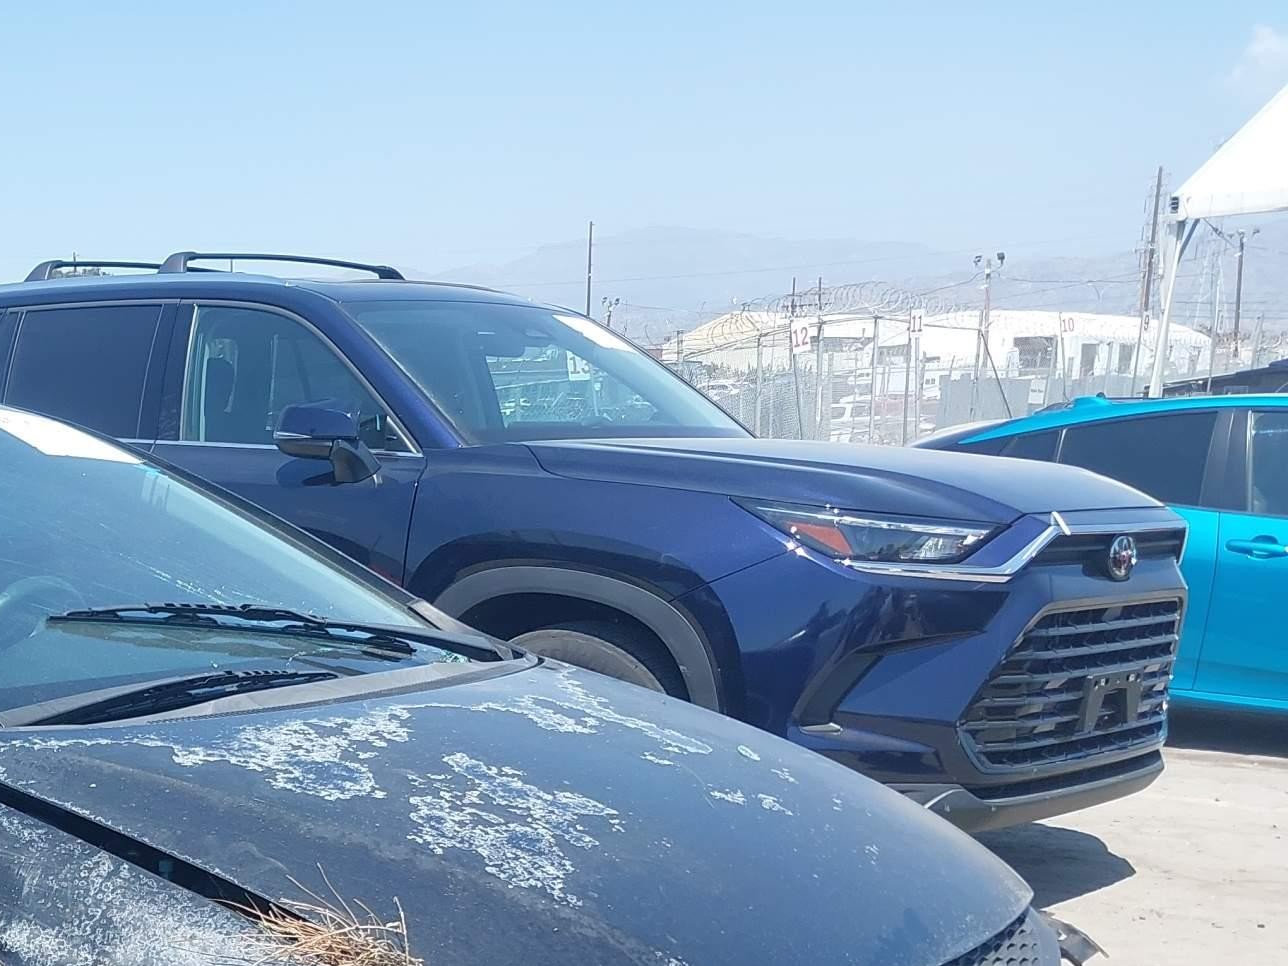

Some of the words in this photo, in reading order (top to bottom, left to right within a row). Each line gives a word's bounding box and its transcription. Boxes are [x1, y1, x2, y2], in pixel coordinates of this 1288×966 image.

[911, 315, 922, 332] 11
[1062, 317, 1075, 332] 10
[792, 326, 809, 347] 12
